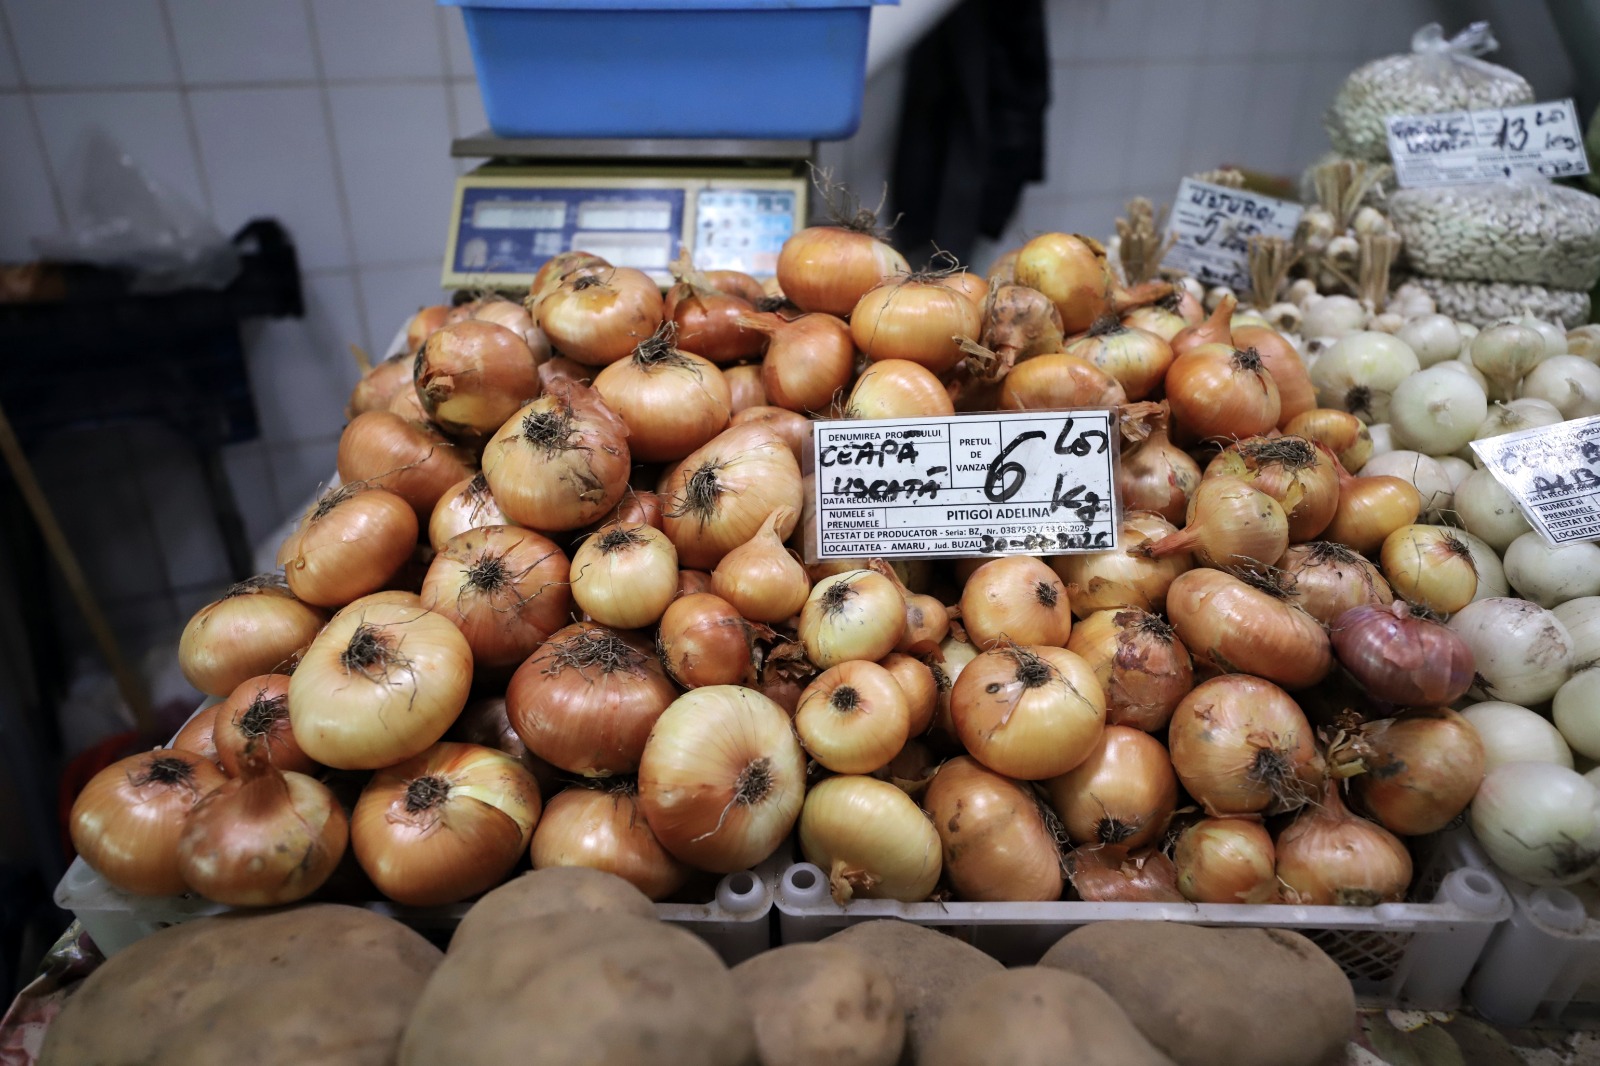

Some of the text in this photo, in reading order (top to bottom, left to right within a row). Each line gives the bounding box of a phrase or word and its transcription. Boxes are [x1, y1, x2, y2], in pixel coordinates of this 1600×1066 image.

[1492, 116, 1528, 152] 13
[828, 429, 941, 442] DENUMIREA PROSULUI
[959, 437, 992, 446] PRETUL
[970, 450, 982, 459] DE
[984, 430, 1047, 503] 6
[823, 497, 845, 505] DATA
[1539, 500, 1575, 513] NUMELE
[829, 509, 875, 519] NUMELE si
[947, 507, 1050, 521] PITIGOI ADELINA
[1543, 505, 1595, 521] PRENUMELE
[827, 519, 880, 529] PRENUMELE
[1547, 517, 1583, 531] ATESTAT
[1583, 514, 1598, 524] DE
[824, 531, 861, 541] ATESTAT
[863, 530, 875, 539] DE
[877, 529, 938, 539] PRODUCATOR
[945, 529, 967, 537] Seria:
[968, 527, 983, 537] BZ,
[986, 527, 999, 535] Nr.
[824, 543, 882, 553] LOCALITATEA
[934, 542, 950, 550] Jud.
[952, 540, 982, 549] BUZAU
